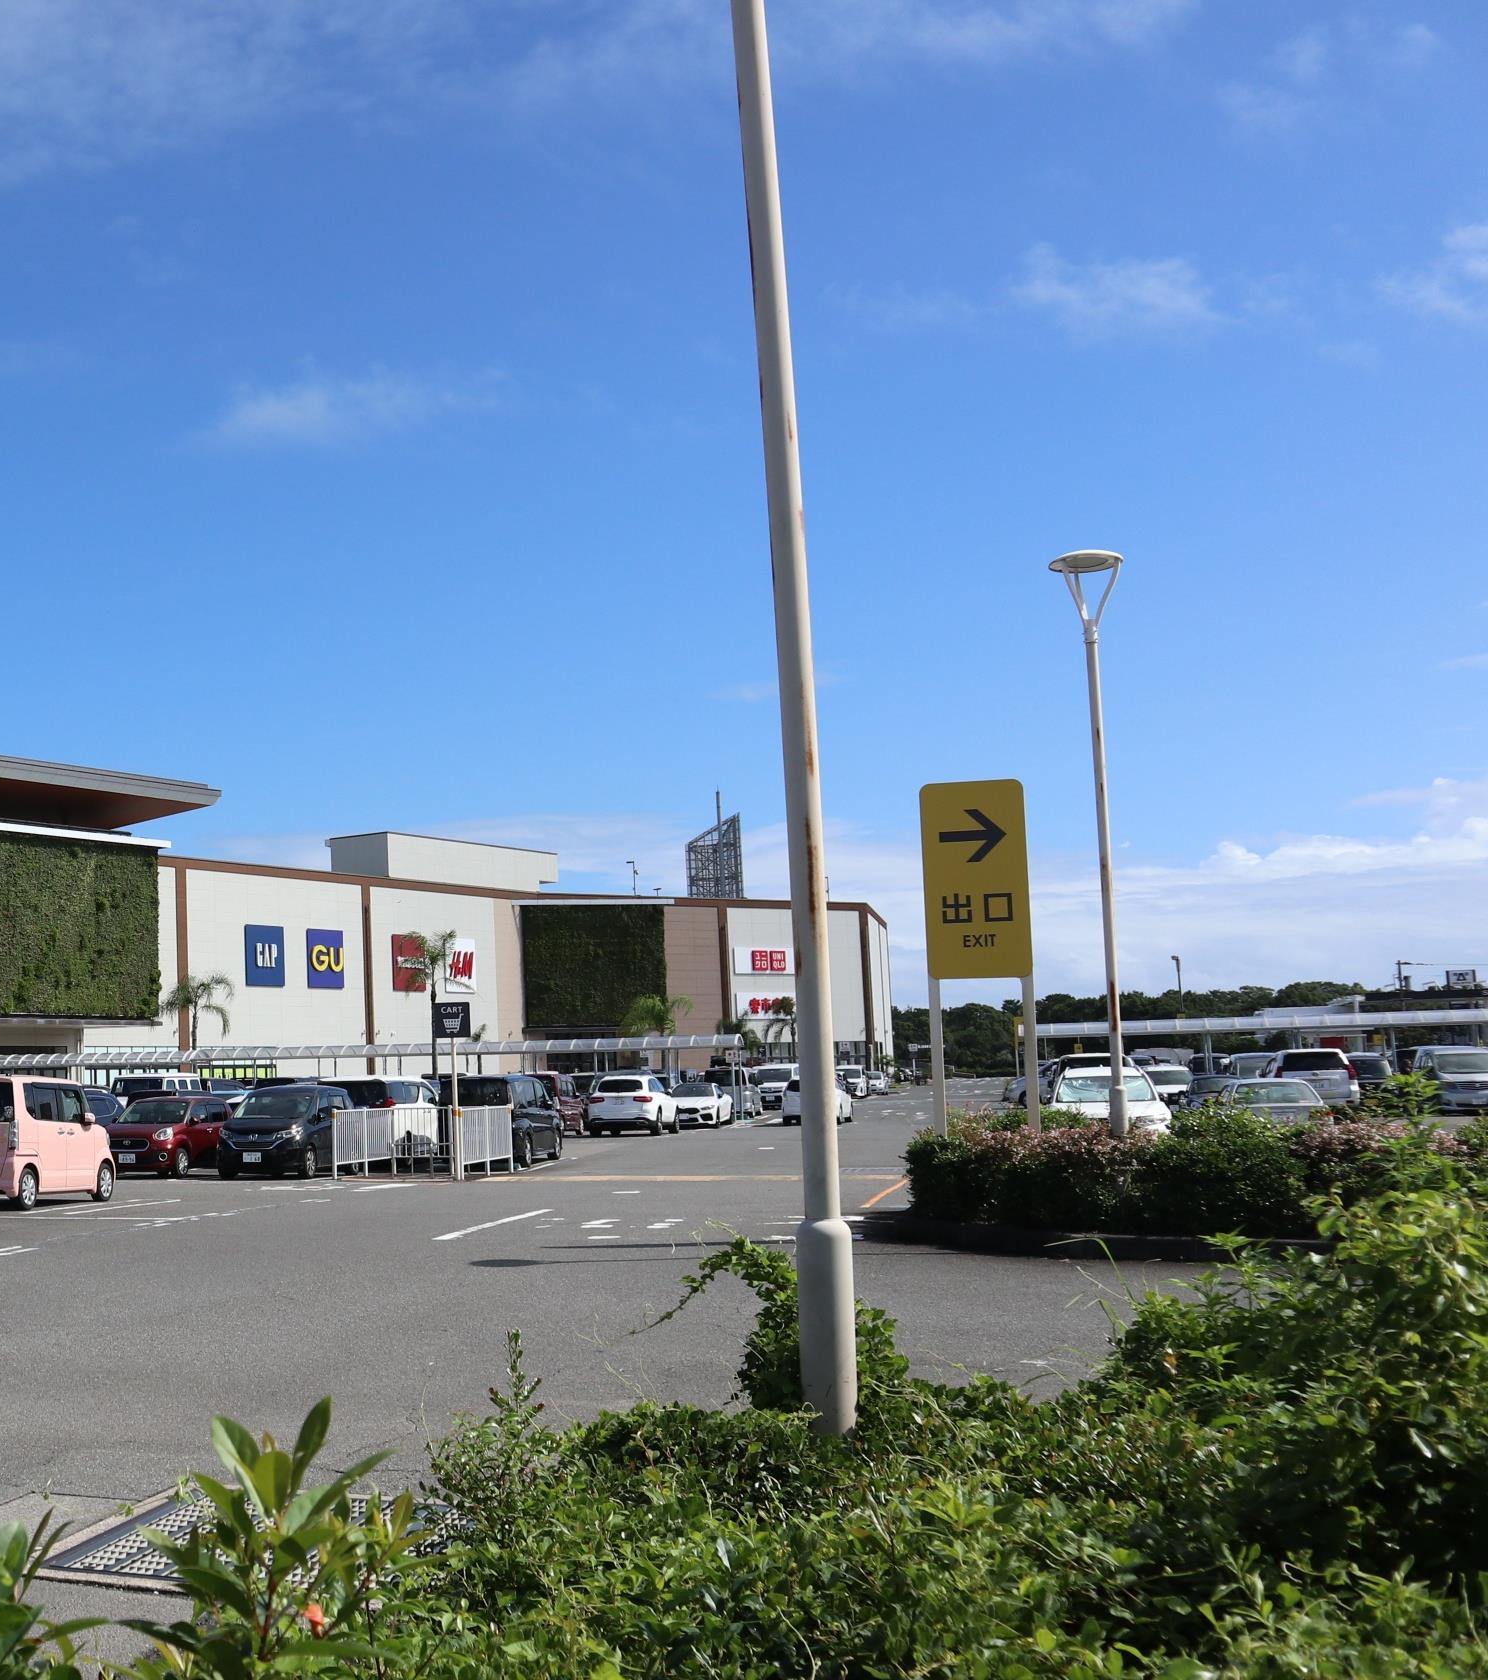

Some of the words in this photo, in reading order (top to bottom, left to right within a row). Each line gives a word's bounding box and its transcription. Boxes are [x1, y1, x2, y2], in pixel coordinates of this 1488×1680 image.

[942, 893, 1014, 924] 出口
[963, 934, 997, 948] EXIT
[256, 942, 278, 968] GAP
[311, 944, 344, 973] GU
[441, 1006, 463, 1014] CART
